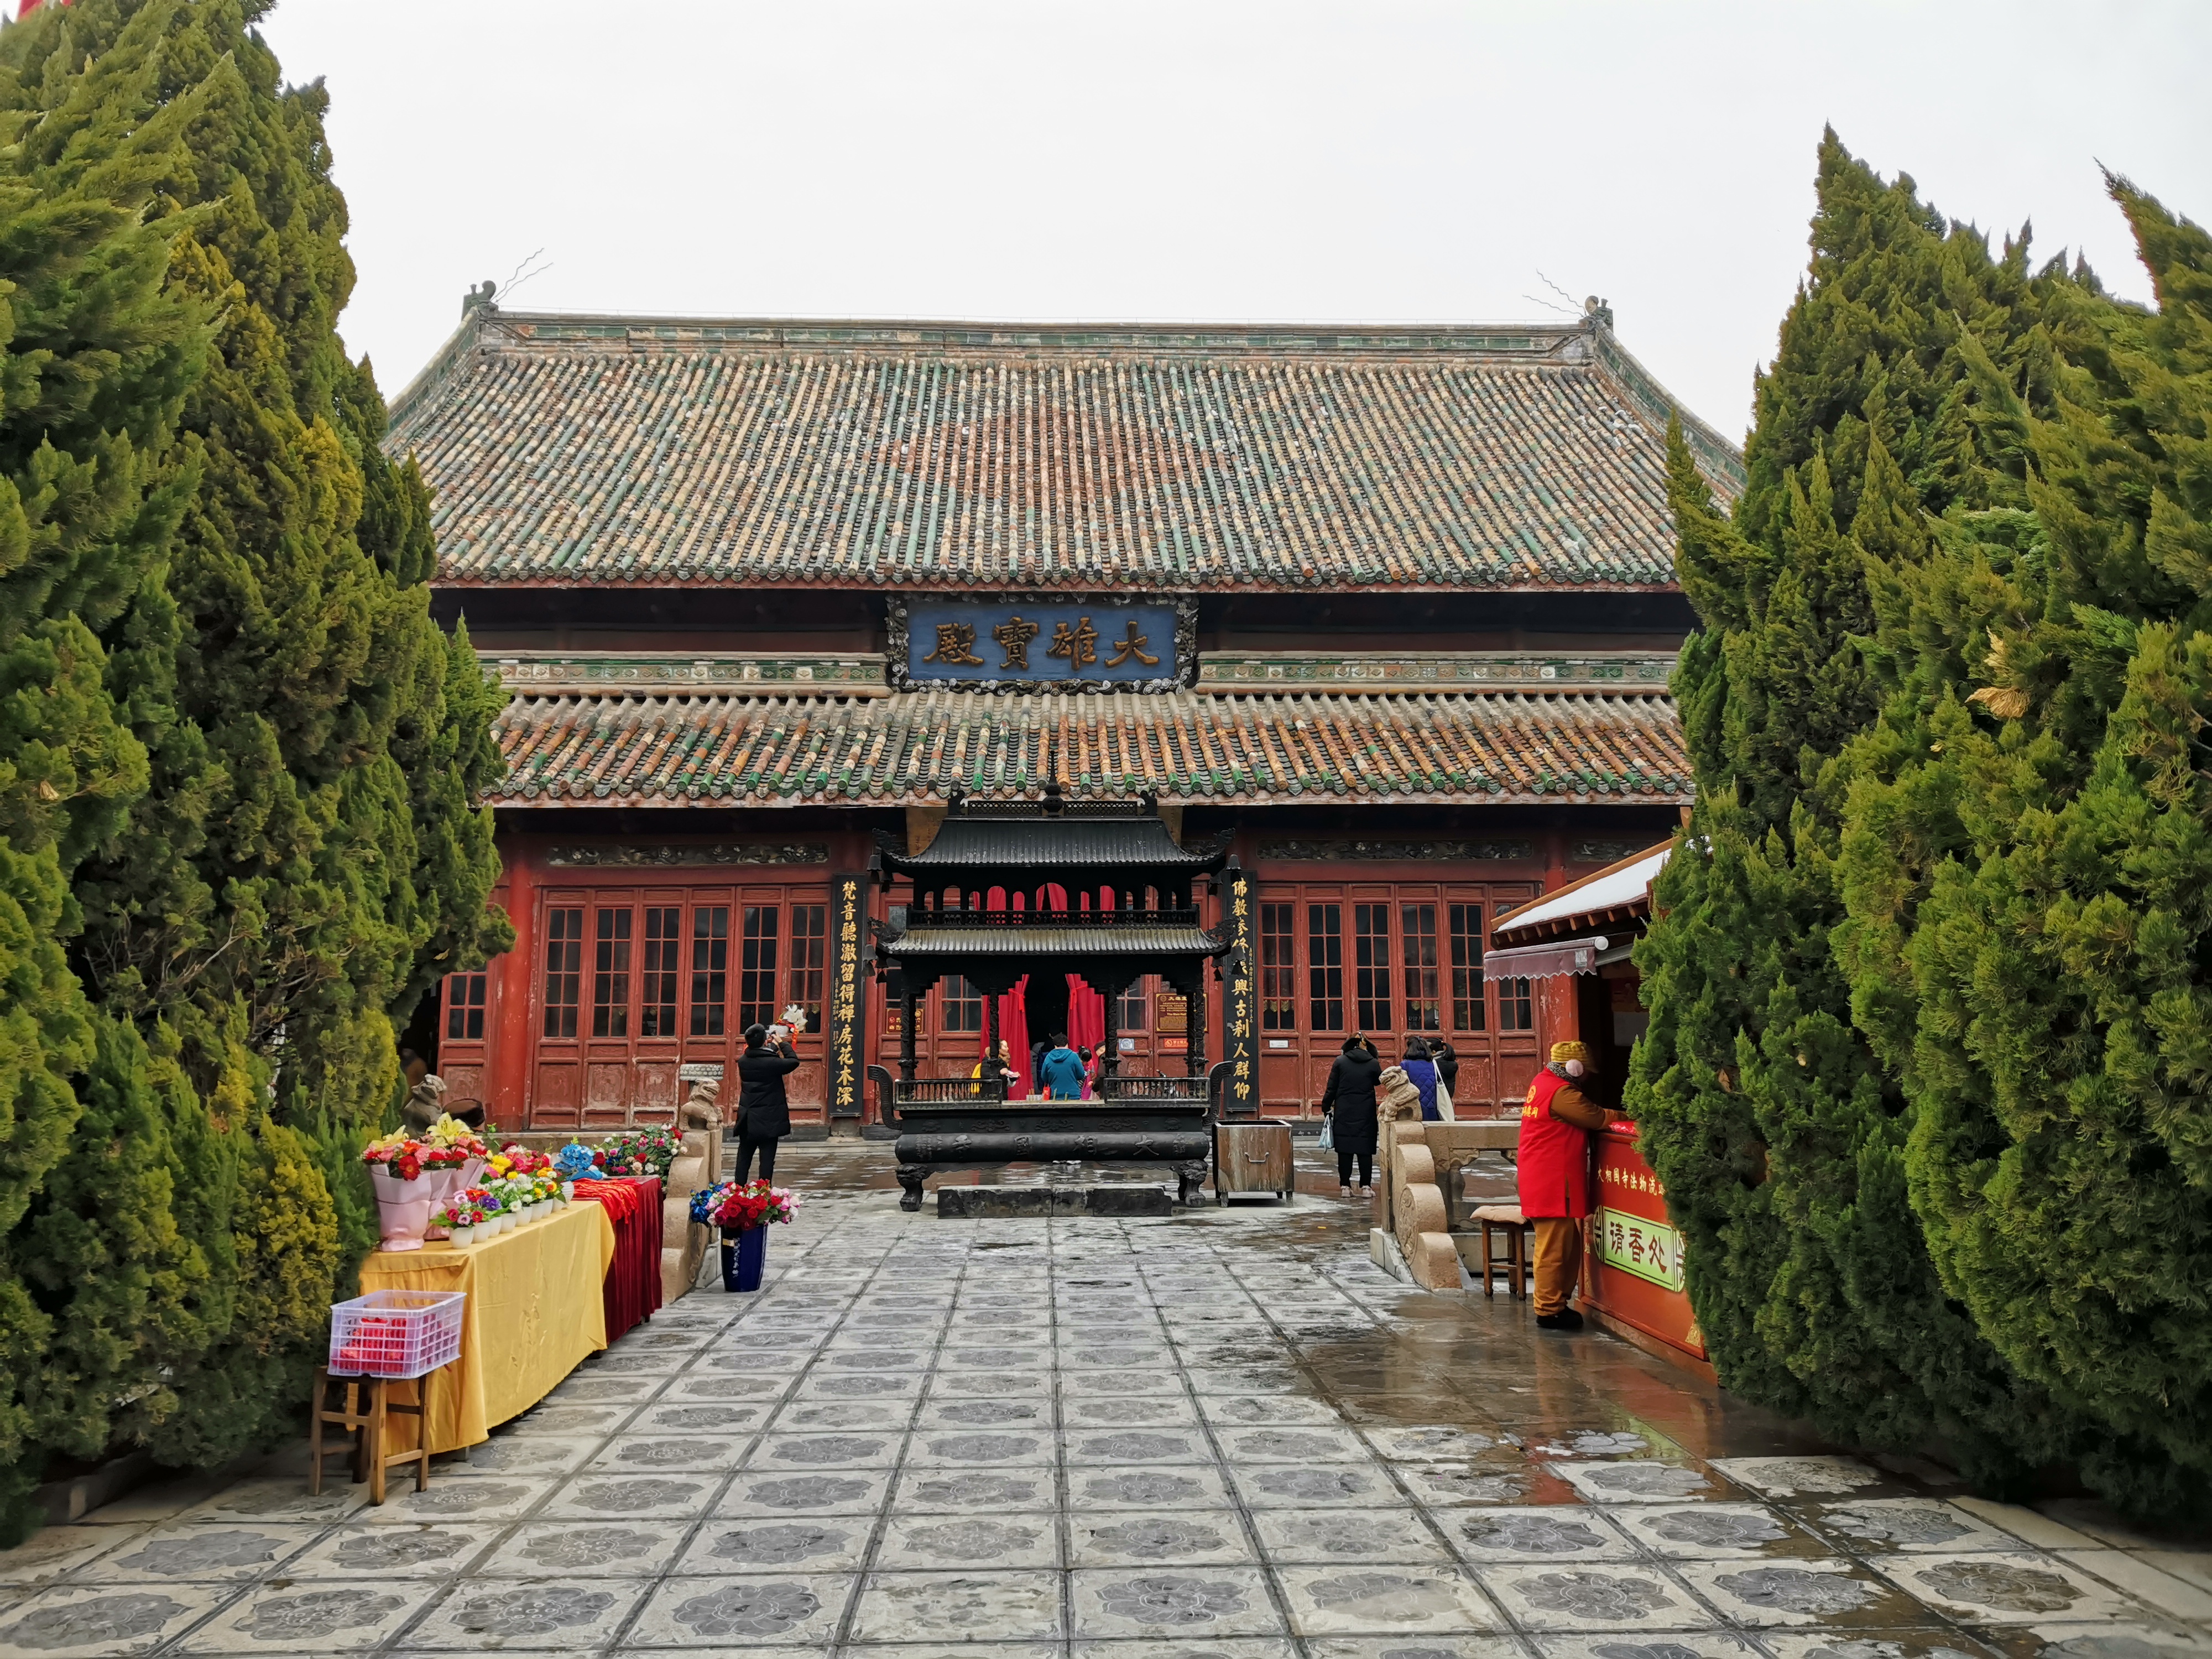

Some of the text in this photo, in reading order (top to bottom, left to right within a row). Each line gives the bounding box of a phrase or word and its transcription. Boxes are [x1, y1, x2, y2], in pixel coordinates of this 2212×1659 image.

[923, 616, 1159, 670] 大雄寶殿
[1610, 1221, 1667, 1274] 请香处
